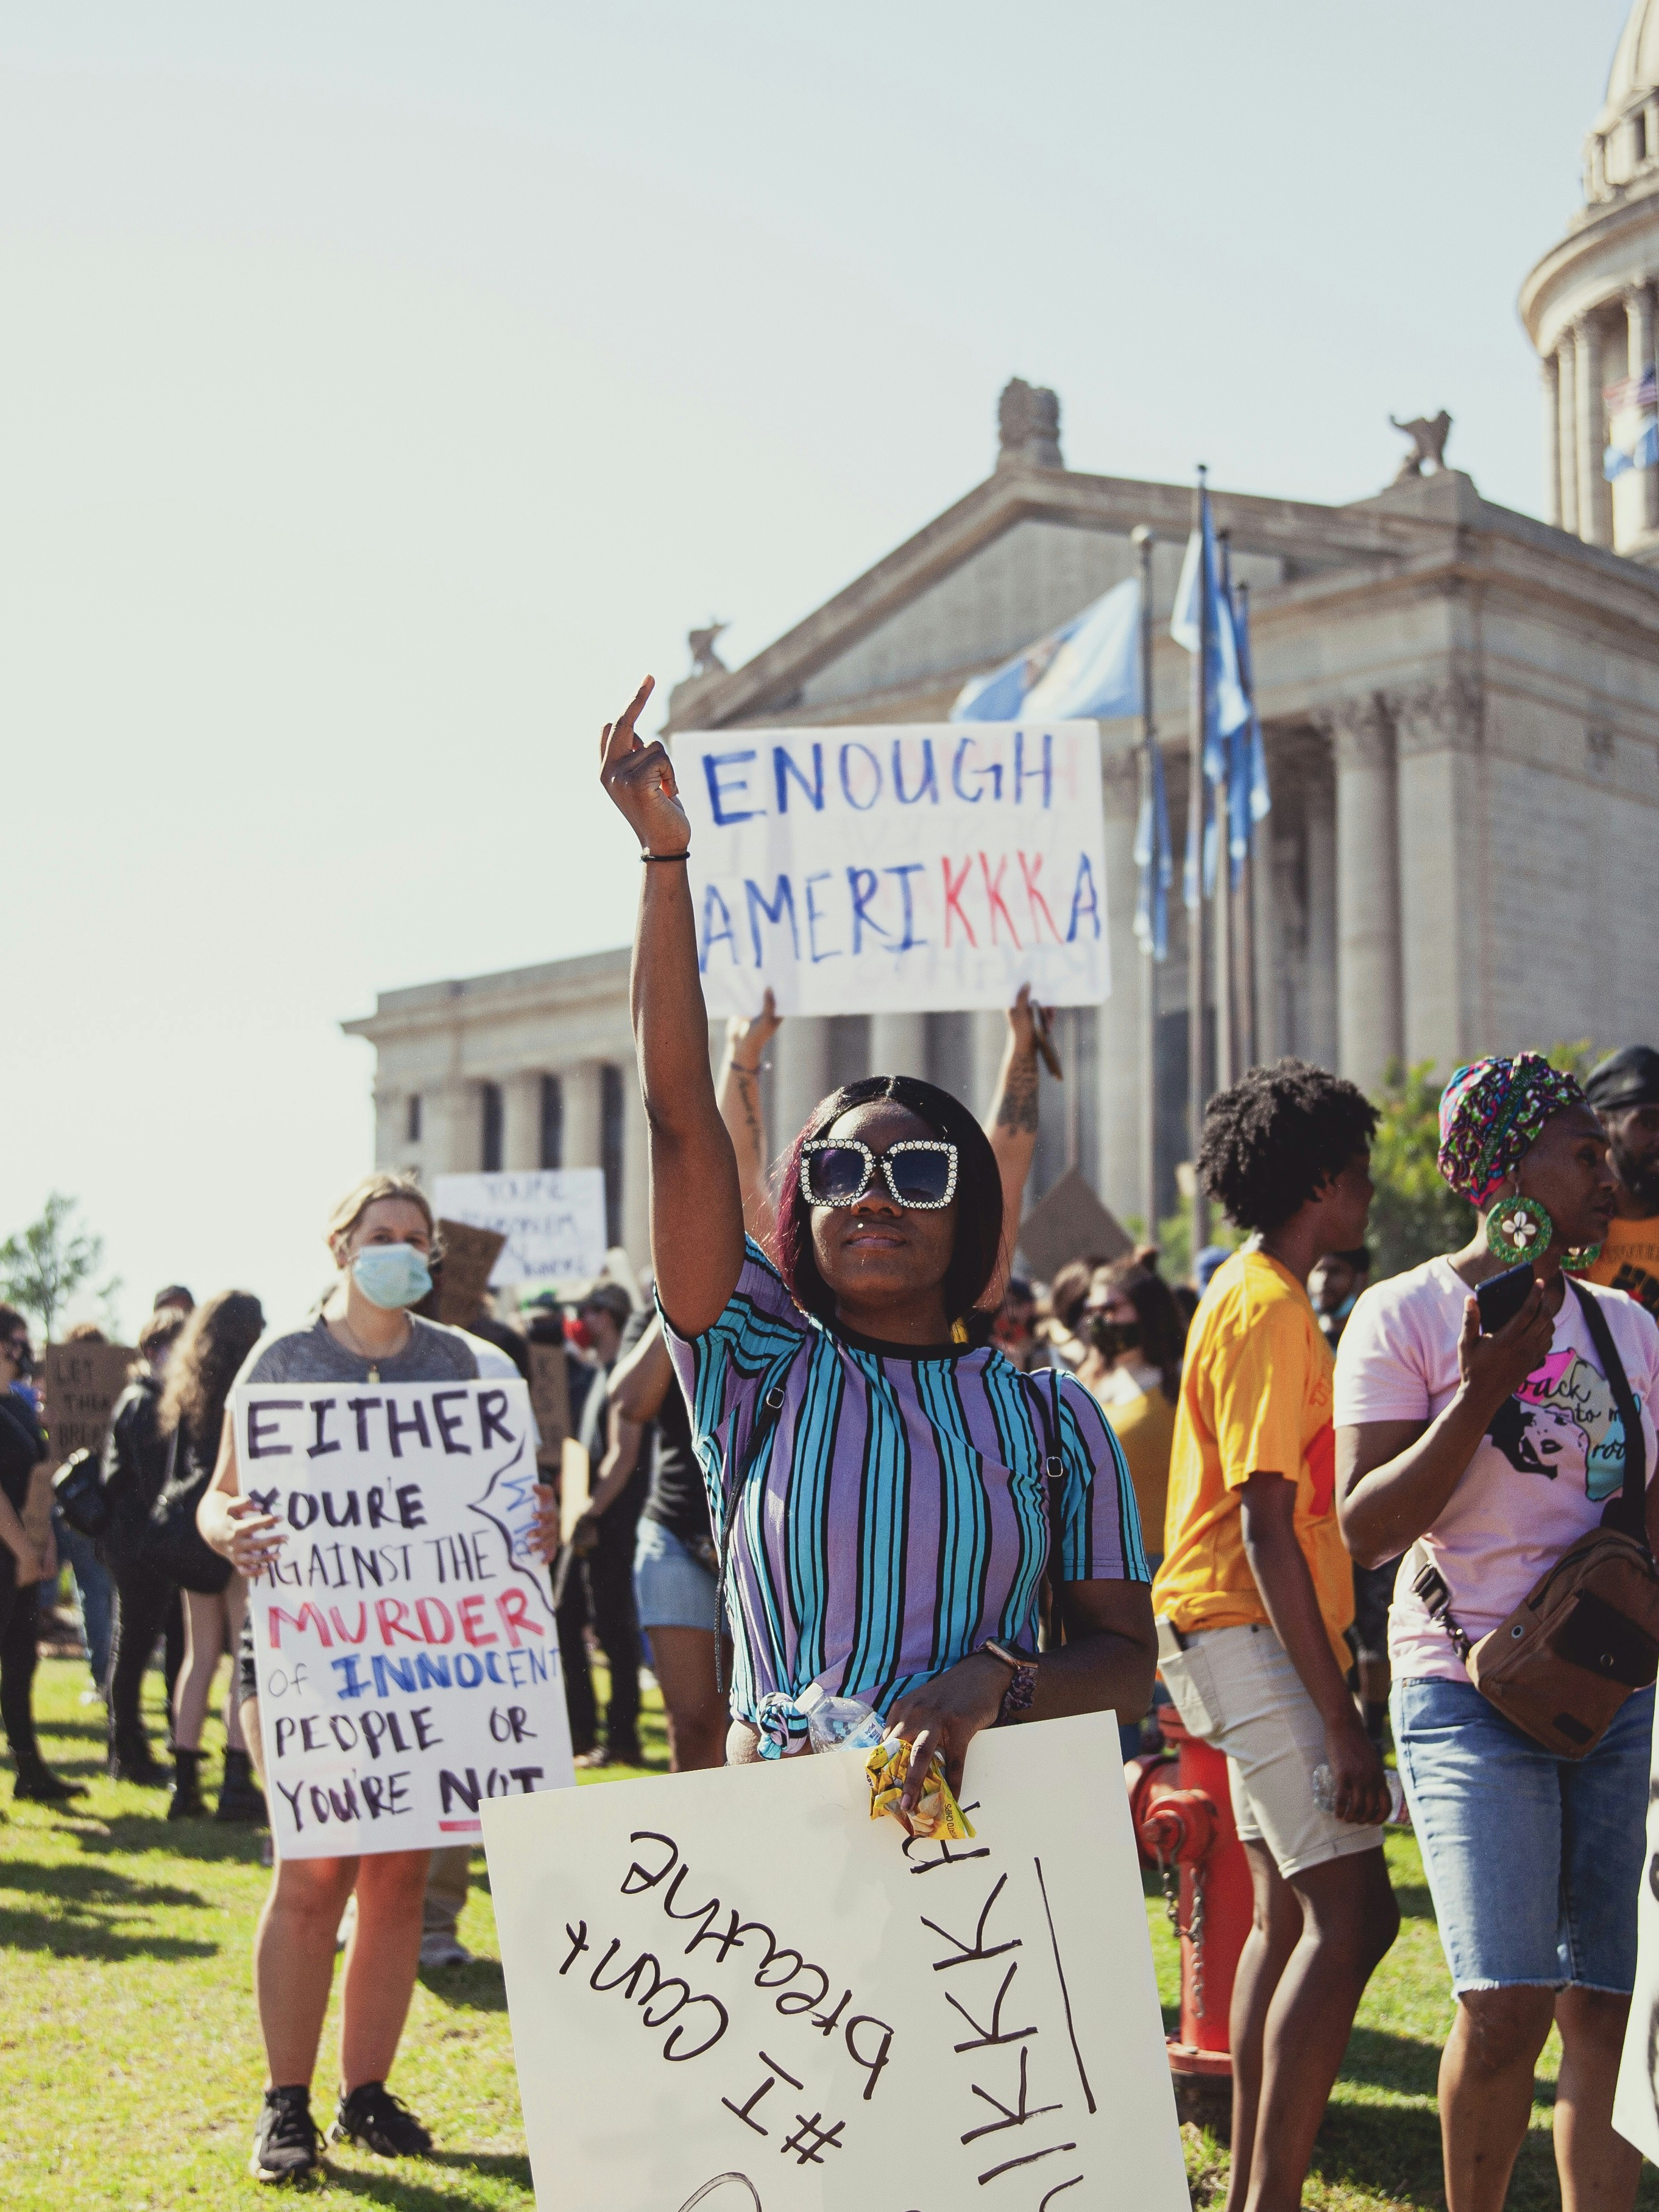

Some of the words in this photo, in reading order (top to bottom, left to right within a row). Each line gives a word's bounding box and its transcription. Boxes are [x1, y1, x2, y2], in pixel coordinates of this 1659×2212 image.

[702, 732, 1052, 825] ENOUGH
[699, 851, 1100, 973] AMERIKKKA
[247, 1390, 517, 1458] EITHER
[1575, 1403, 1602, 1422] to
[423, 1530, 496, 1583] THE
[269, 1588, 545, 1648] MURDER
[330, 1648, 559, 1699] INNOCENT
[275, 1707, 444, 1759] PEOPLE
[490, 1706, 537, 1743] OR
[277, 1768, 413, 1832] YOU'RE
[439, 1767, 544, 1814] NOT
[944, 1804, 953, 1821] CHIPS
[620, 1831, 896, 2101] breathe
